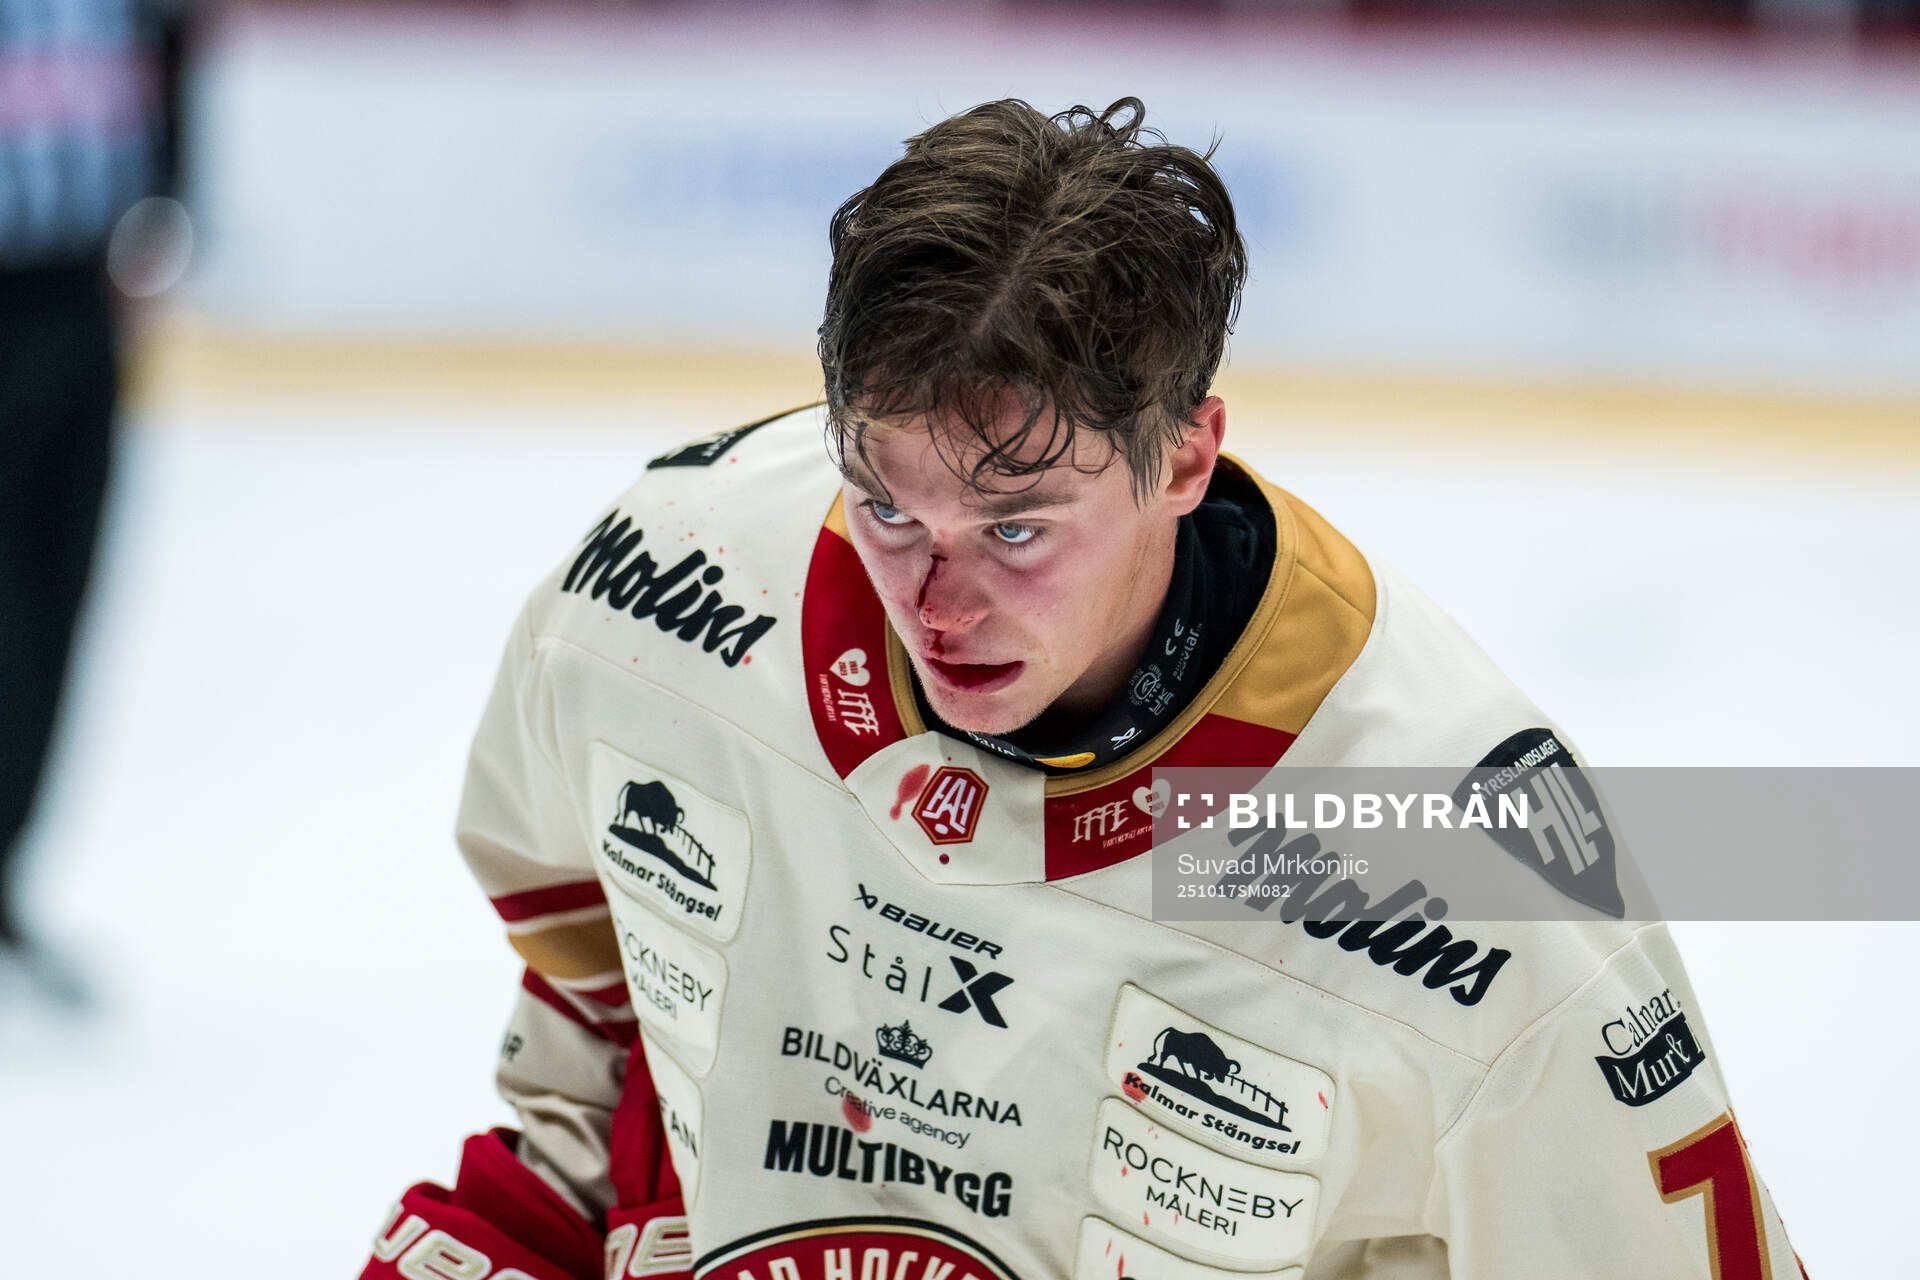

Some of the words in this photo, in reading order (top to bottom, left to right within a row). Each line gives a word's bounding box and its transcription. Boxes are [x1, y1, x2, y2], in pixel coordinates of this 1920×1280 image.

[561, 507, 777, 667] Molins
[1470, 738, 1559, 801] YRESLANDSLAGET
[603, 838, 655, 882] Kalmar
[1217, 811, 1511, 1006] Molins
[617, 918, 713, 1012] CKNEBY
[781, 1027, 1023, 1127] BILDVÄXLARNA
[825, 1076, 896, 1120] Creative
[899, 1113, 971, 1149] agency
[1124, 1072, 1200, 1118] Kalmar
[1202, 1113, 1302, 1155] Stängsel
[764, 1120, 1013, 1218] MULTIBYGG
[1103, 1126, 1304, 1219] ROCKNEBY
[1146, 1186, 1237, 1236] MÅLERI
[824, 1248, 990, 1280] HOCK
